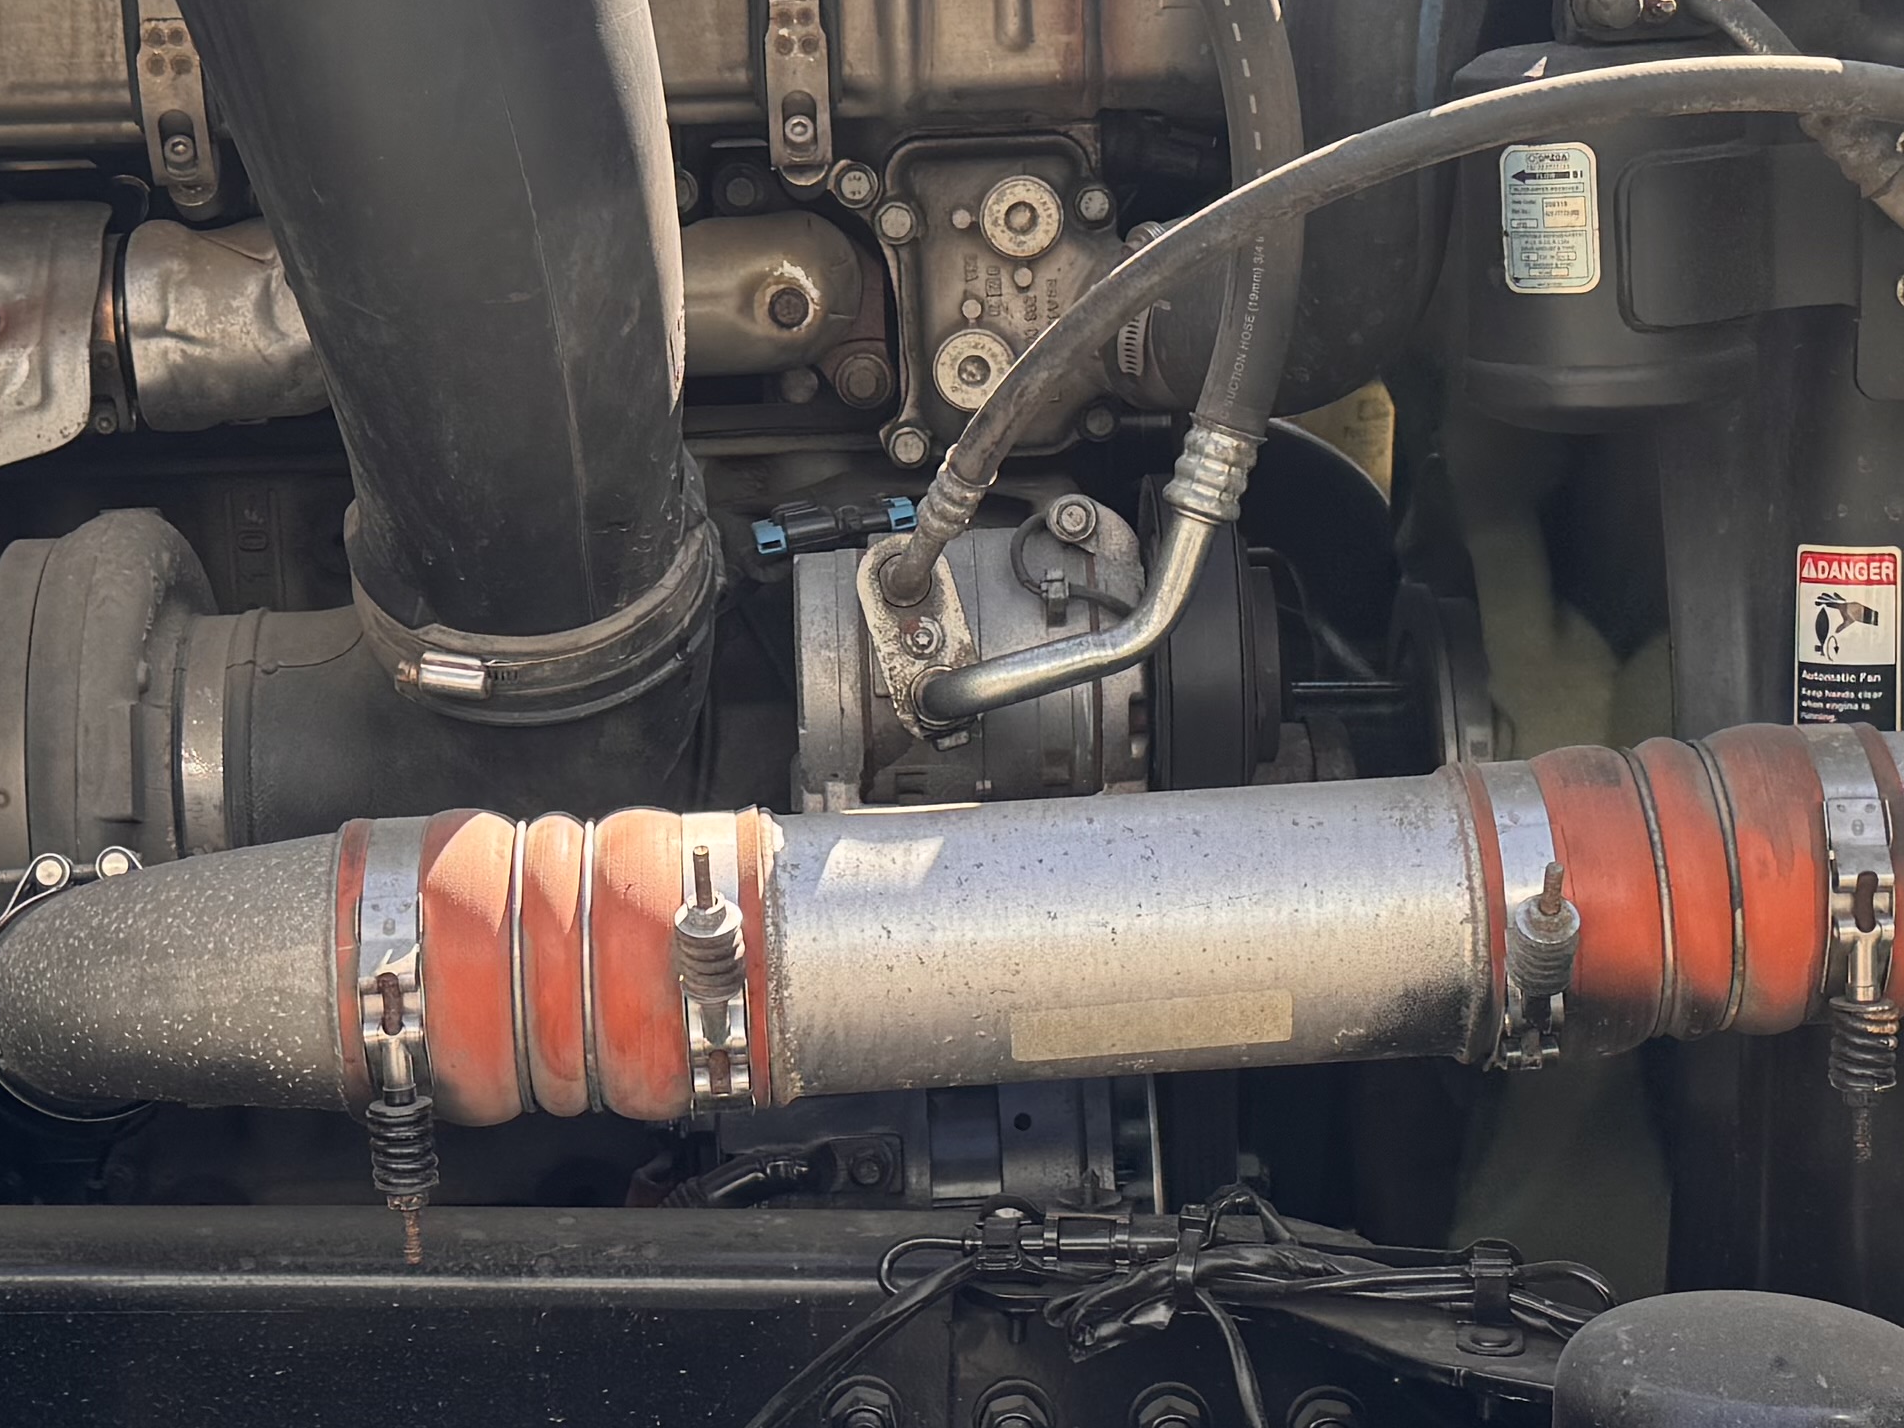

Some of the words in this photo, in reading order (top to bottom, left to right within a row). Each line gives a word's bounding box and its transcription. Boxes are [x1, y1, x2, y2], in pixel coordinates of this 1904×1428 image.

[1253, 244, 1265, 265] 3/4
[1247, 267, 1265, 312] (19mm)
[1240, 314, 1256, 351] HOSE
[1816, 560, 1895, 582] DANGER
[1801, 669, 1857, 683] Automatic
[1859, 672, 1882, 683] Fan
[1801, 687, 1823, 699] Keep
[1824, 689, 1855, 699] hands
[1858, 689, 1883, 699] clear
[1825, 702, 1859, 712] engine
